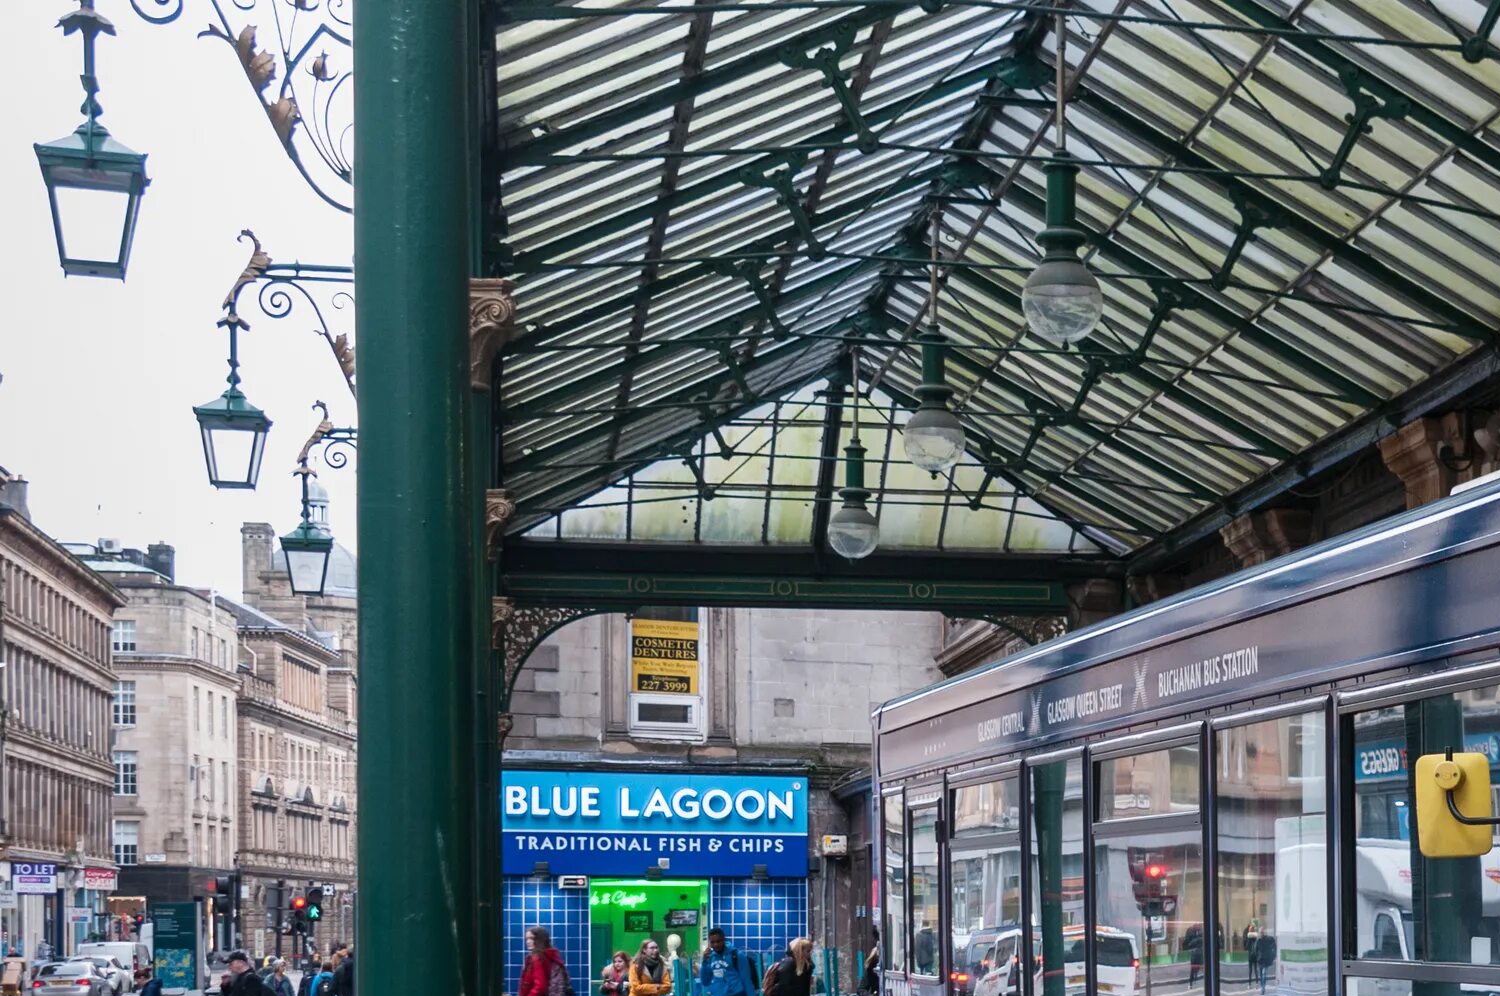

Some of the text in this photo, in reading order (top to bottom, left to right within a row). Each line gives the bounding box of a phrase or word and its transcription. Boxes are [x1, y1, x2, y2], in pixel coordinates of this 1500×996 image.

[635, 637, 695, 650] COSMETIC
[634, 647, 696, 659] DENTURES
[1158, 646, 1258, 698] BUCHANAN BUS STATION
[641, 680, 688, 692] 227 3999
[1047, 683, 1122, 725] GLASGOW QUEEN STREET
[978, 711, 1025, 741] GLASGOW CENTRAL
[505, 786, 793, 820] BLUE LAGOON
[515, 836, 784, 853] TRADITIONAL FISH & CHIPS
[14, 863, 55, 875] TO LET
